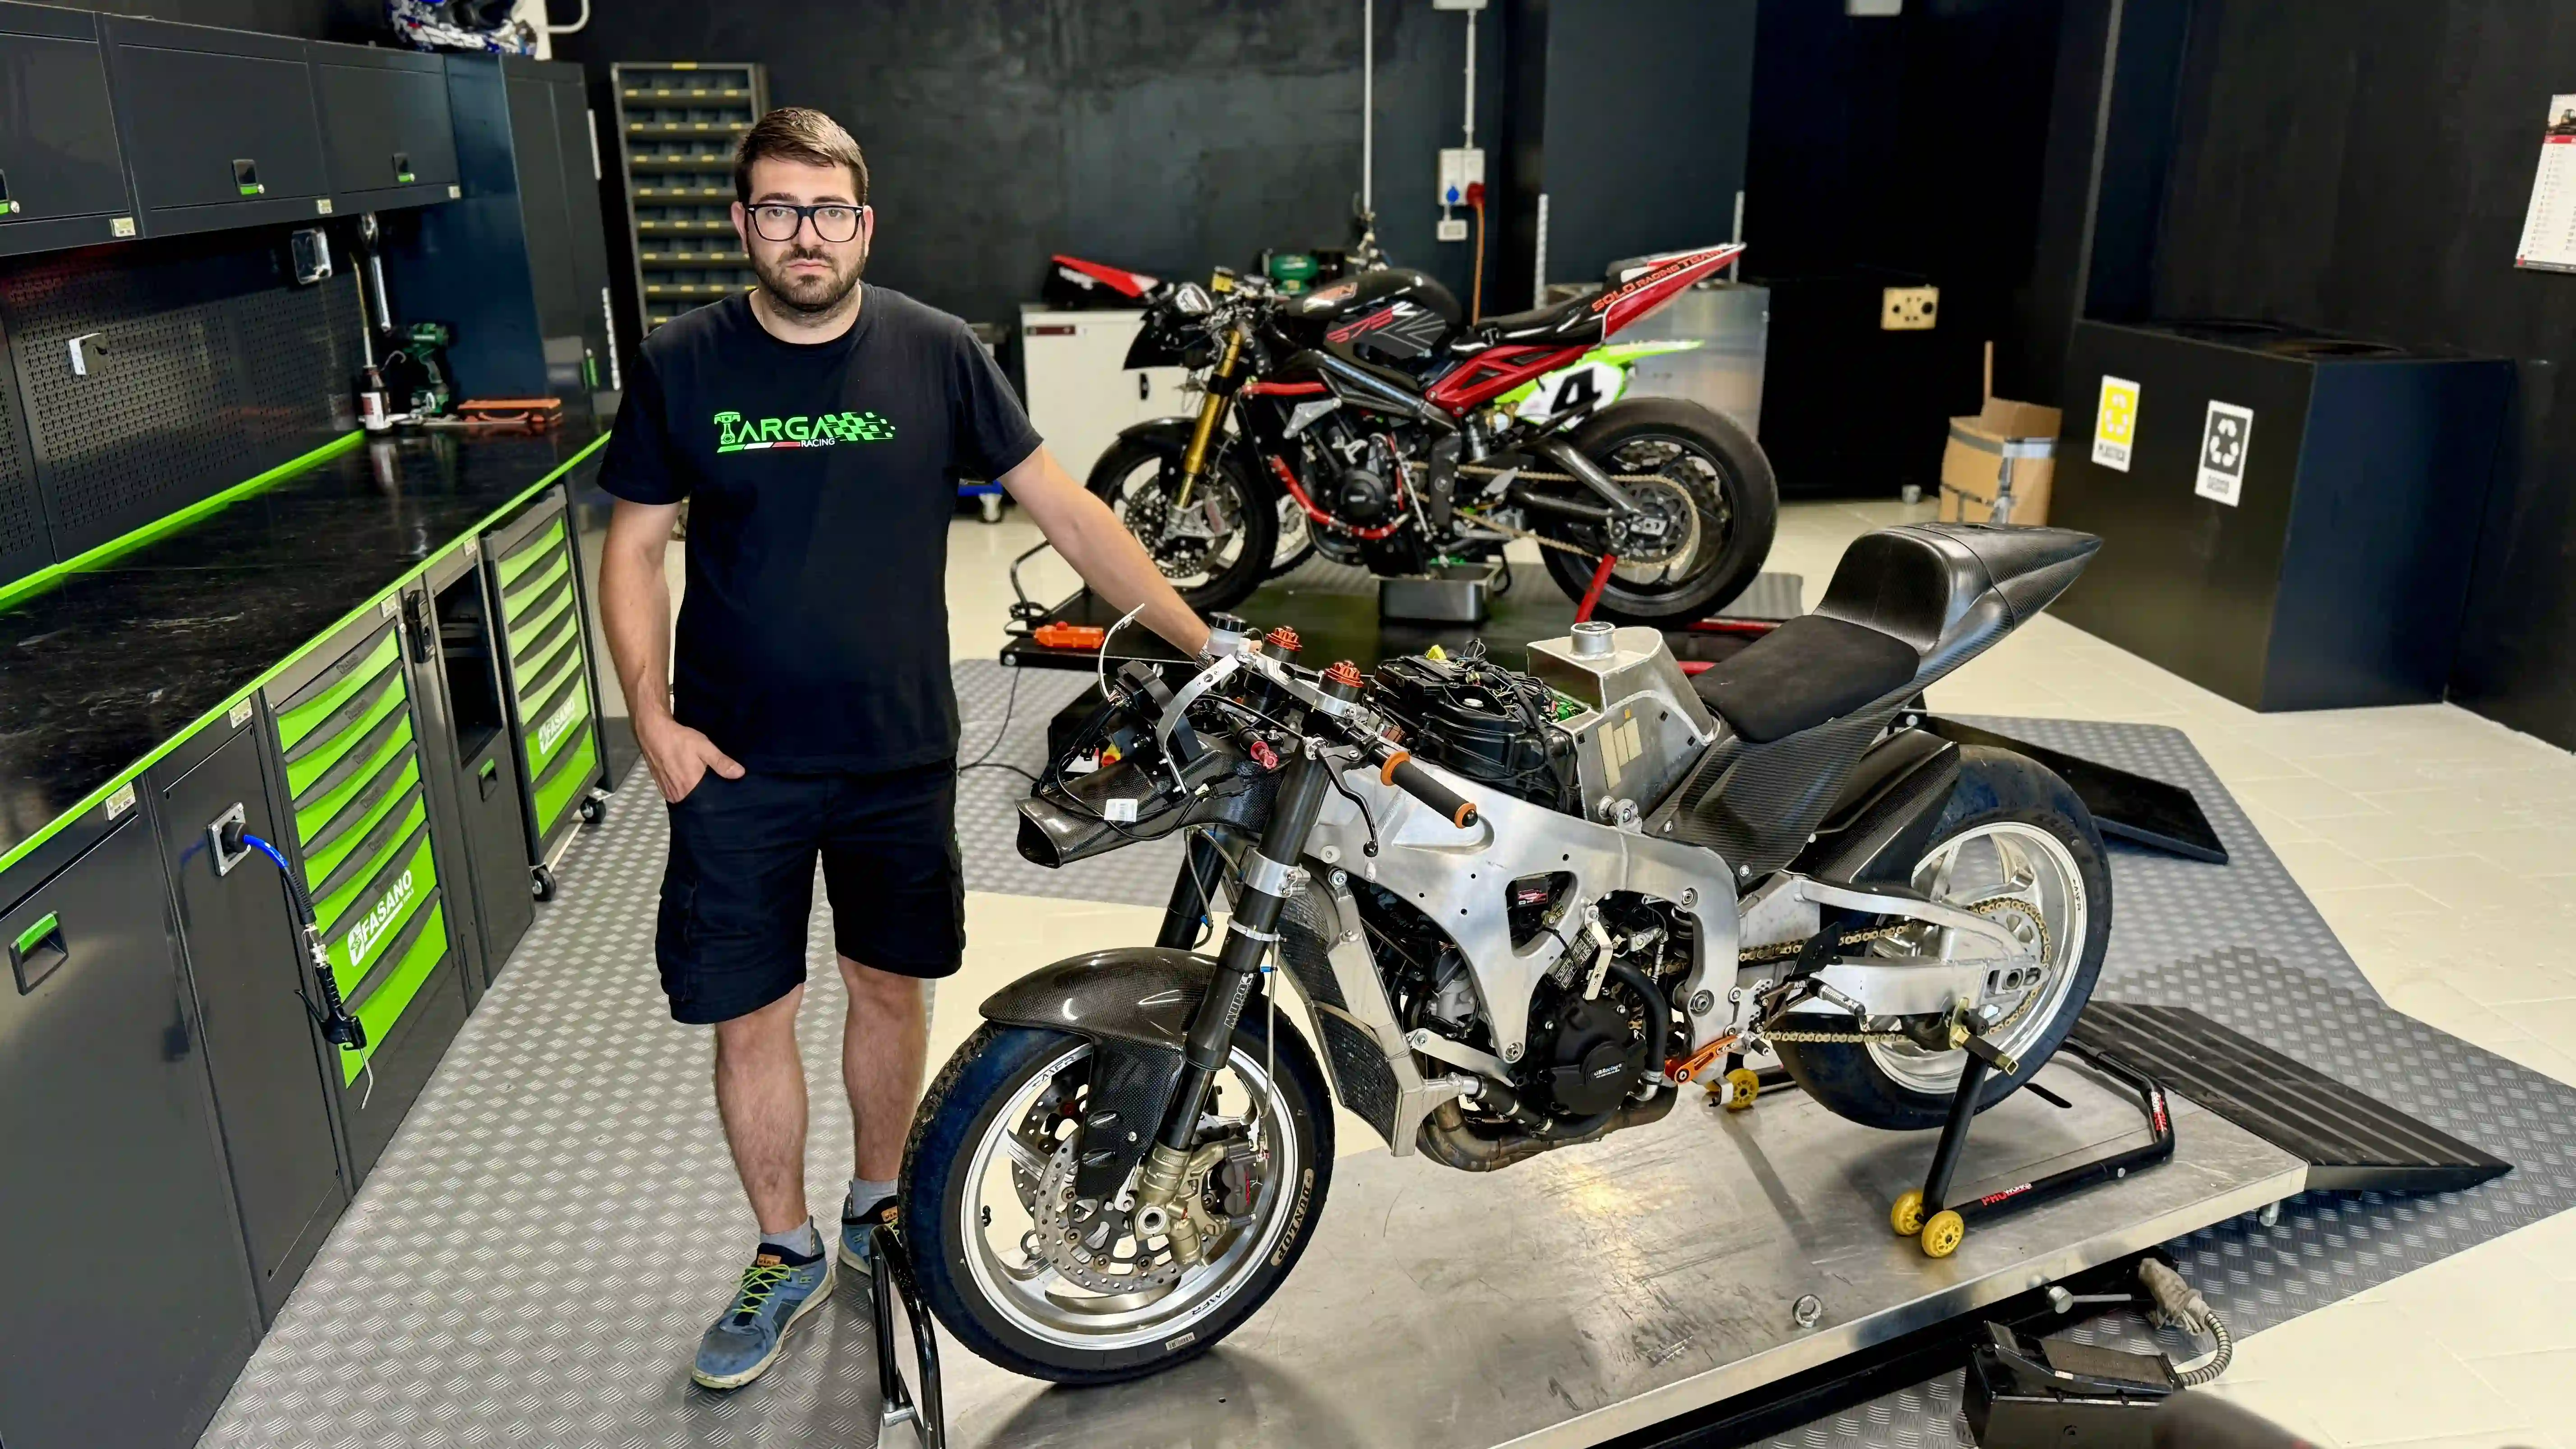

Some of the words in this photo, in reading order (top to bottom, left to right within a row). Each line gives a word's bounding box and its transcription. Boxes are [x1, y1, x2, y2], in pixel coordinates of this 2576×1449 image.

[1592, 283, 1636, 313] SOLO
[1636, 265, 1680, 288] RACING
[1550, 367, 1602, 415] 4
[800, 437, 835, 448] RACING
[361, 869, 412, 943] FASANO
[1278, 1183, 1311, 1260] DUNLOP
